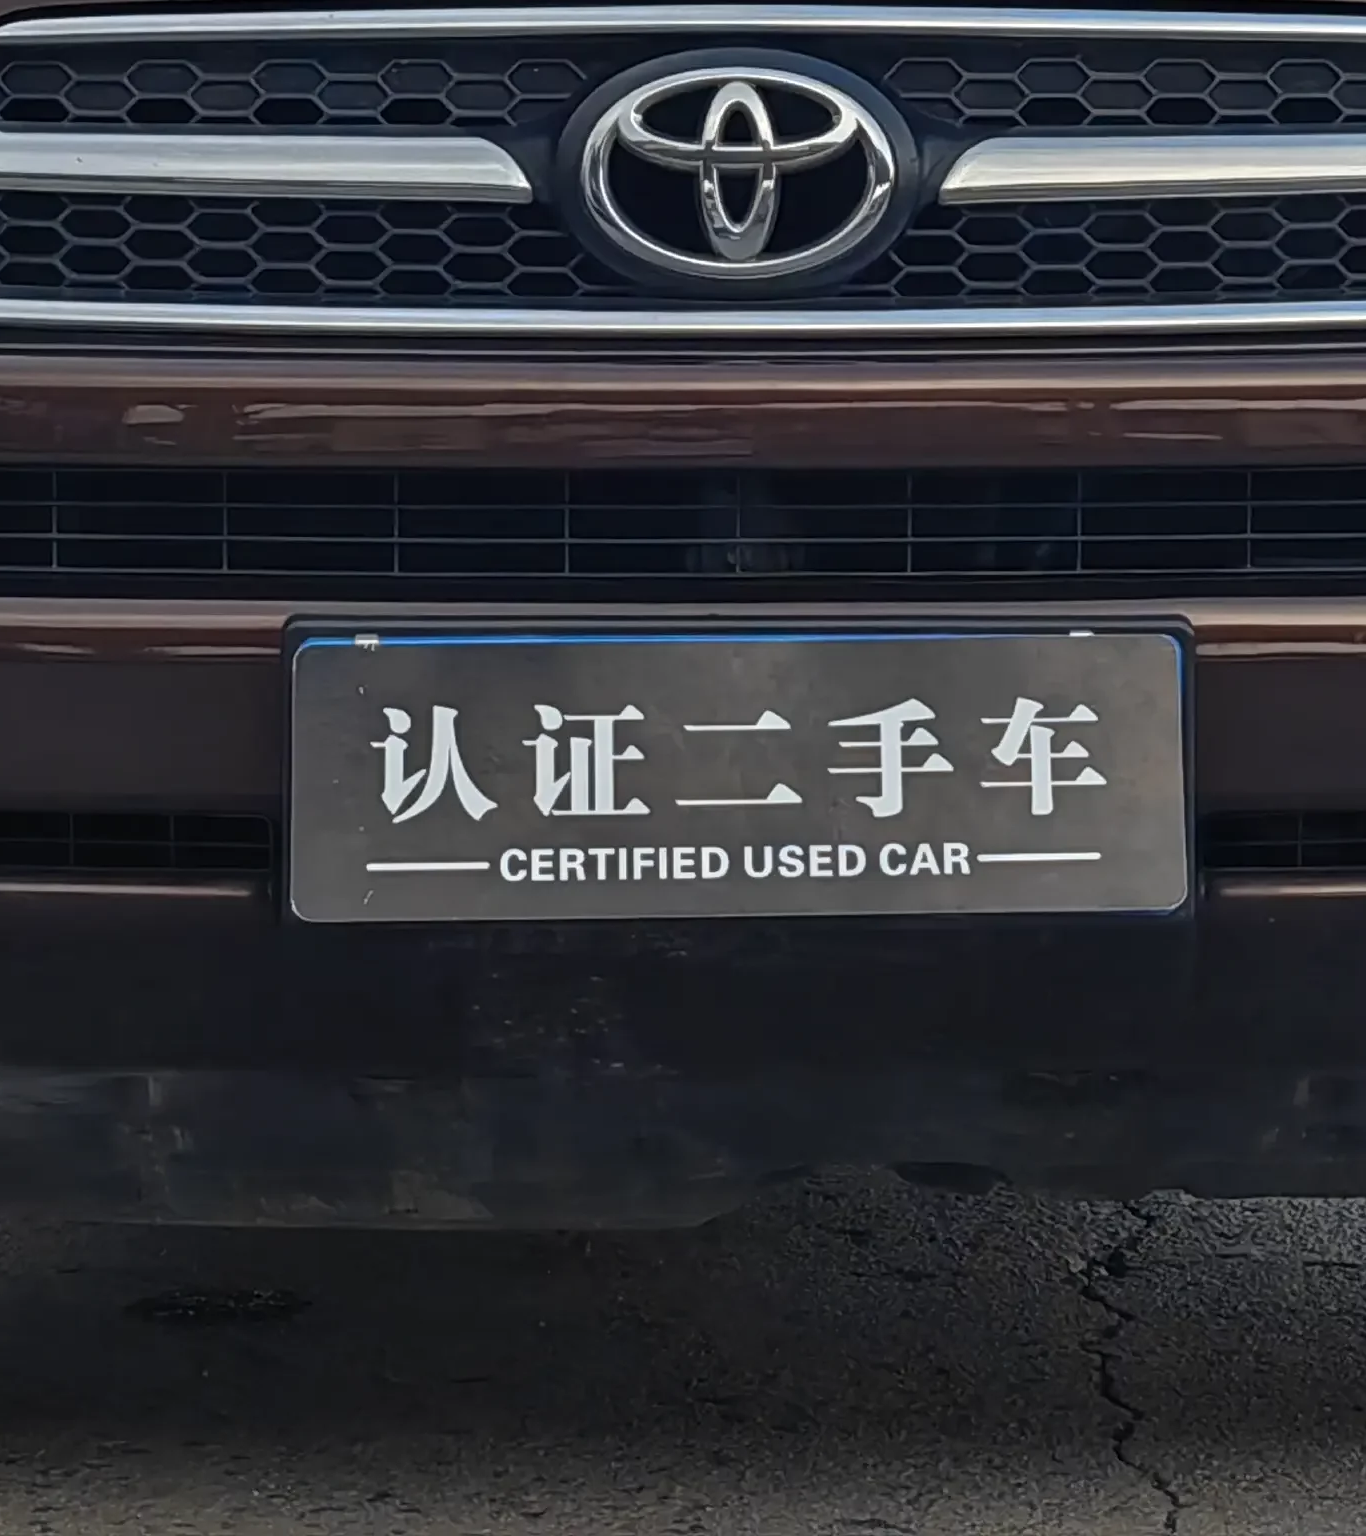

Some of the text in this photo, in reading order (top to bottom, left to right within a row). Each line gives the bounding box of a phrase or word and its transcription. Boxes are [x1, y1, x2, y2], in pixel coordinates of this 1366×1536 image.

[371, 697, 1107, 823] 认证二手车
[499, 842, 971, 882] CERTIFIED USED CAR
